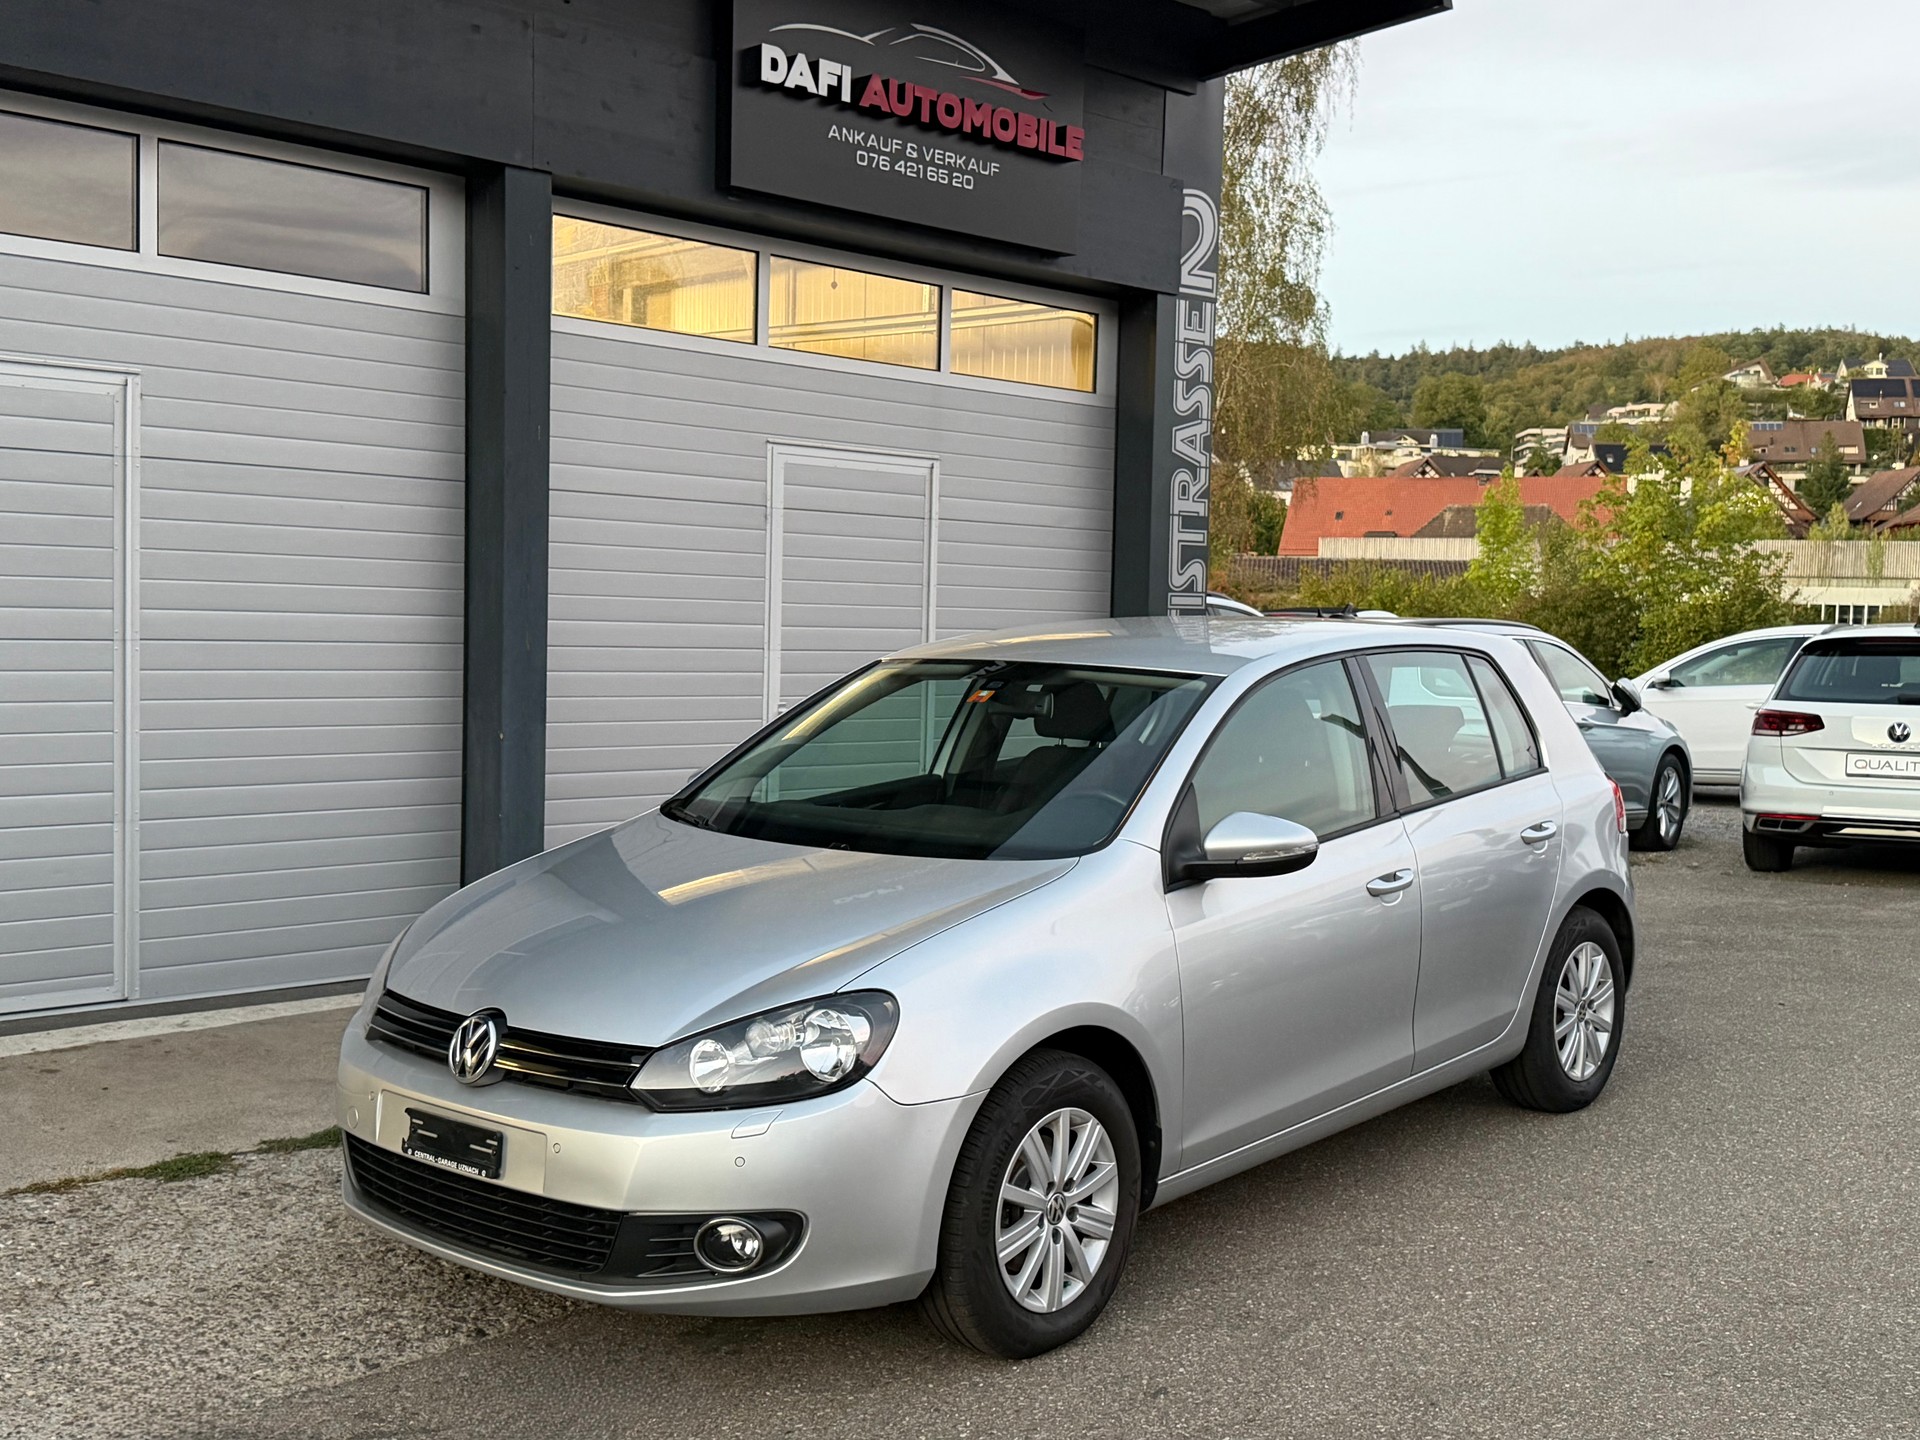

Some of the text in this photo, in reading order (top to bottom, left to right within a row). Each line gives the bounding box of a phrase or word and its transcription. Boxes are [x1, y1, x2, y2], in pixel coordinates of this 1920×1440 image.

[761, 43, 1084, 161] DAFI AUTOMOBILE
[828, 125, 1000, 177] ANKAUF & VERKAUF
[856, 150, 974, 190] 076 421 65 20
[1167, 188, 1219, 616] ISTRASSE 2
